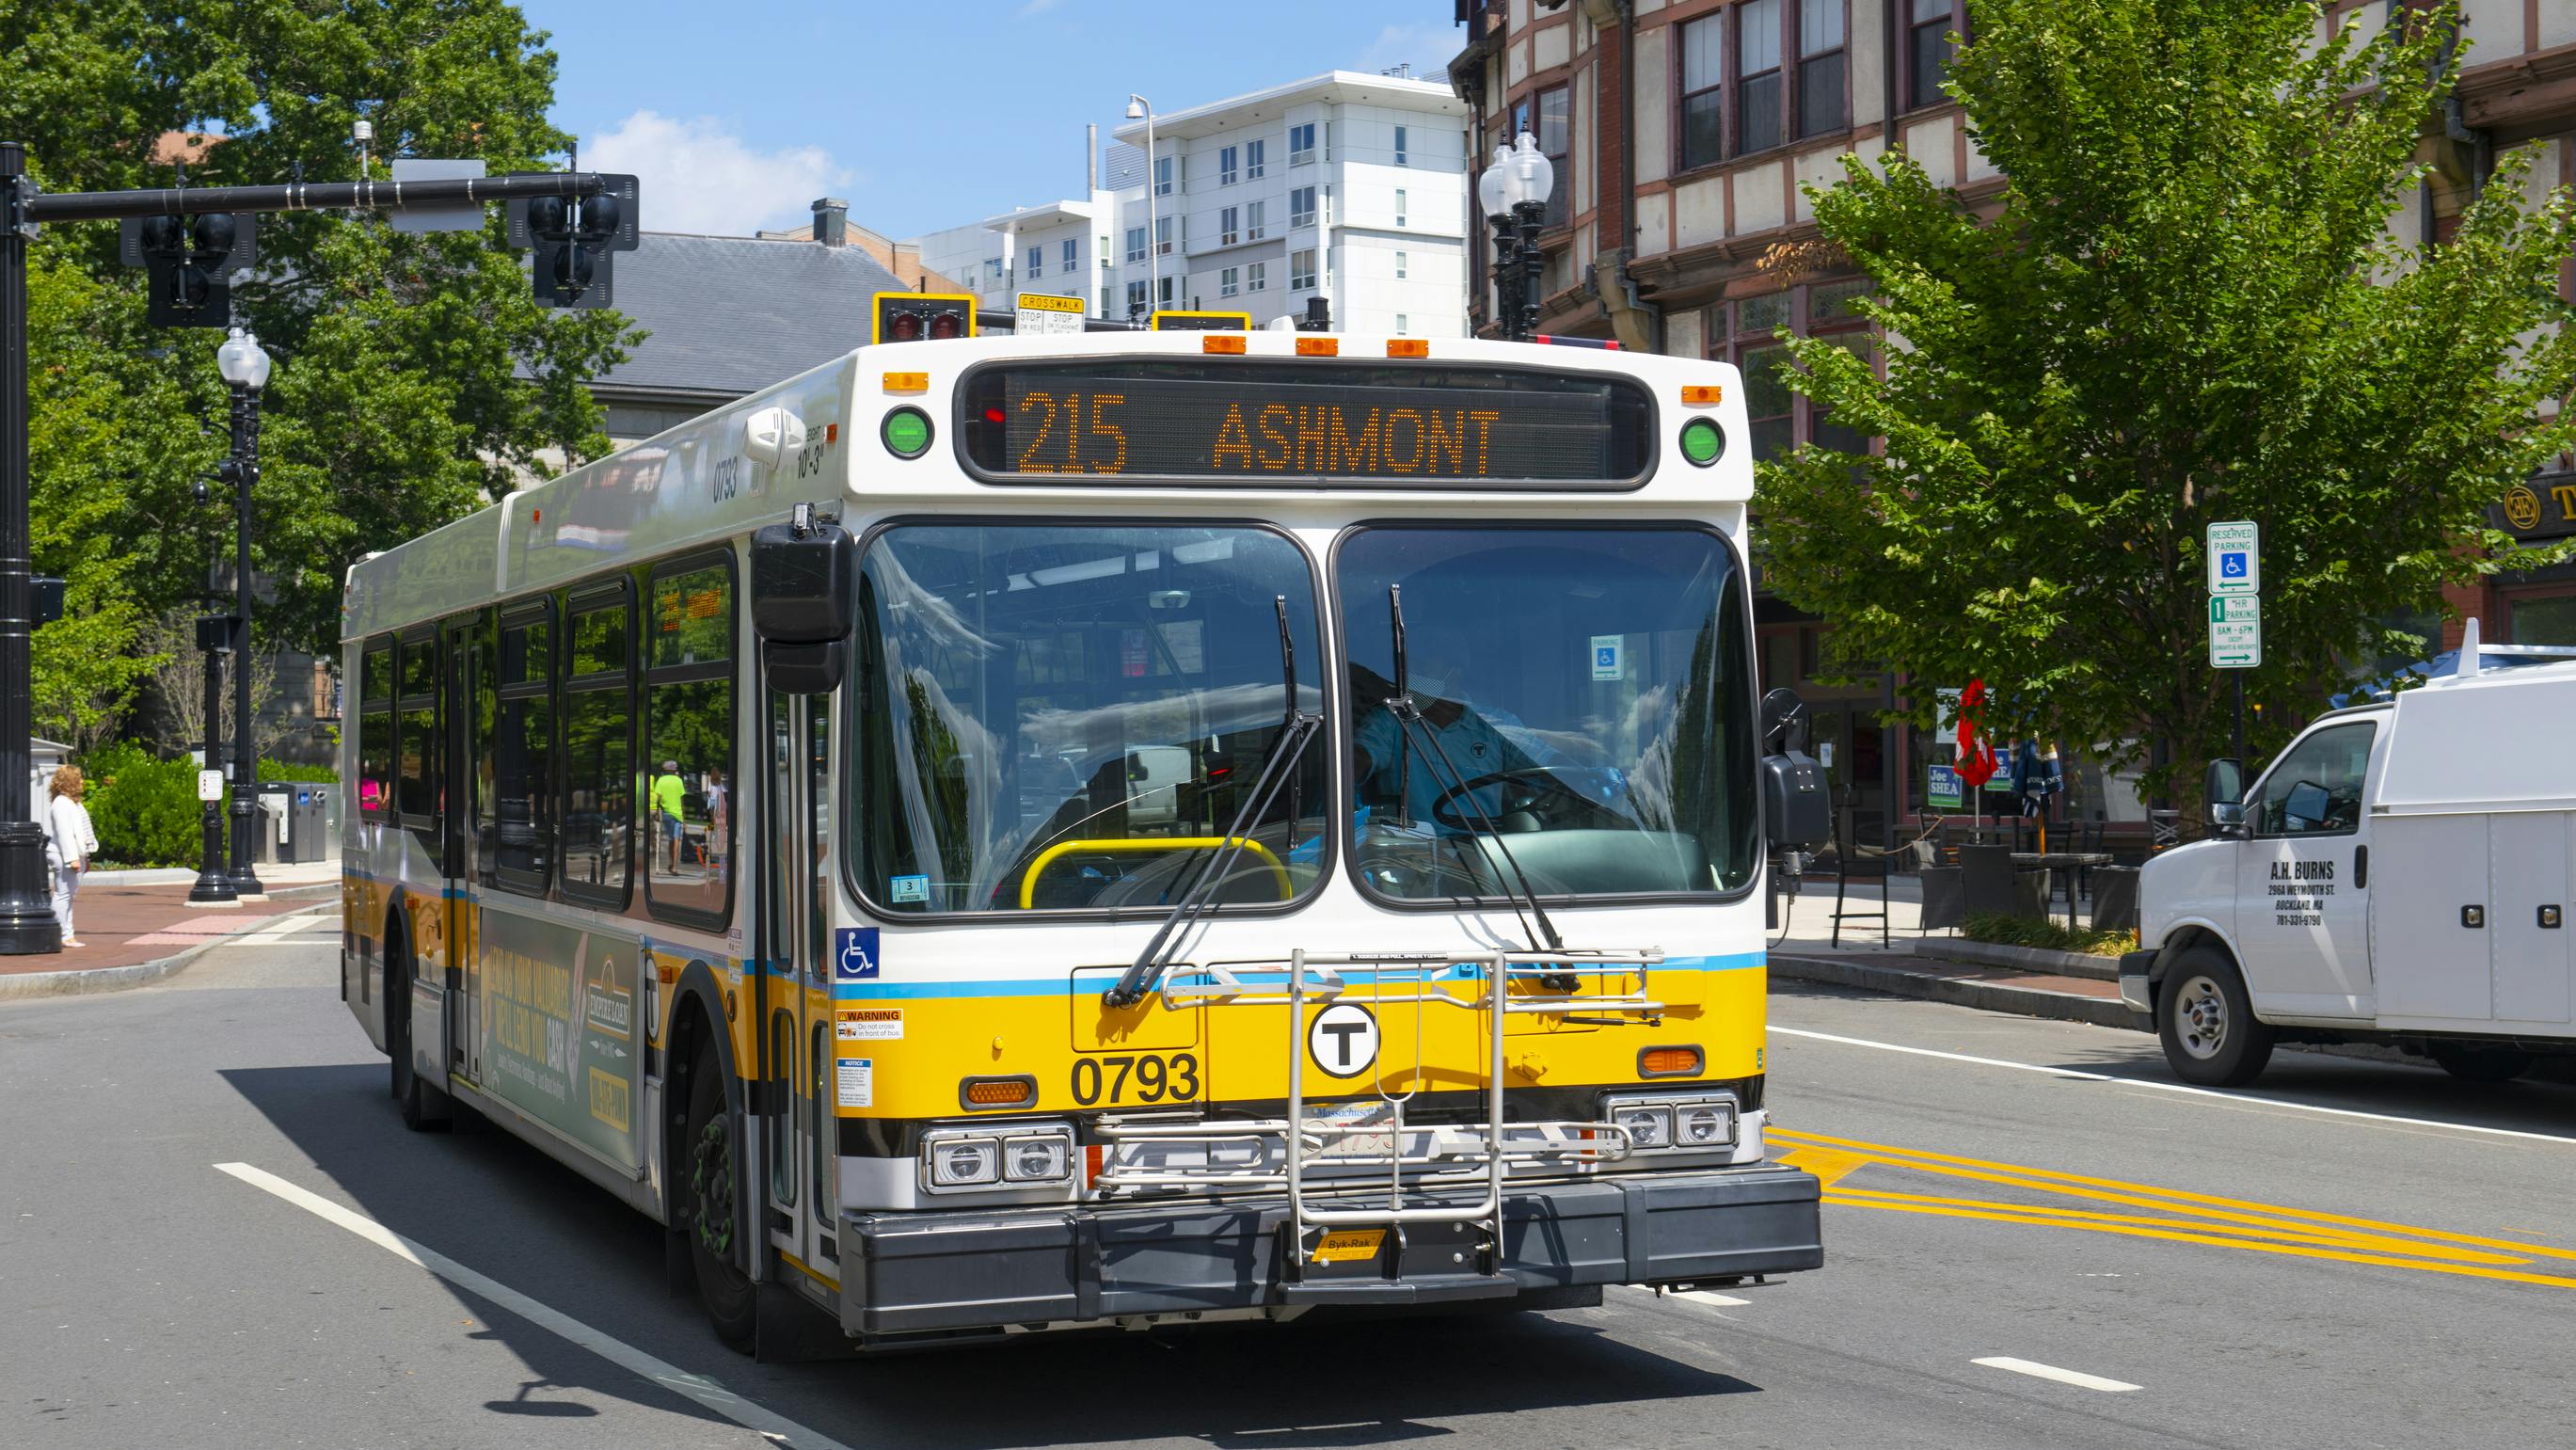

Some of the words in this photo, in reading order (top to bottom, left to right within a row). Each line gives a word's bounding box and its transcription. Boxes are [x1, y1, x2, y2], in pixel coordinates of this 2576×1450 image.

[1023, 296, 1080, 311] CROSSWALK
[1020, 311, 1042, 322] STOP
[1054, 313, 1073, 323] STOP
[1019, 391, 1127, 474] 215
[1213, 403, 1501, 475] ASHMONT
[713, 455, 739, 503] 0793
[2212, 530, 2252, 540] RESERVED
[2214, 542, 2250, 551] PARKING
[2215, 601, 2221, 619] 1
[2234, 599, 2248, 608] HR
[2226, 610, 2257, 619] PARKING
[2217, 626, 2232, 635] 8AM
[2238, 625, 2253, 635] 6PM
[1931, 770, 1948, 782] Joe
[1931, 782, 1959, 795] SHEA
[2270, 861, 2292, 880] A.H.
[2295, 860, 2334, 880] BURNS
[906, 882, 913, 891] 3
[2287, 884, 2325, 896] WEYMOUTH
[2313, 900, 2324, 911] MA
[590, 994, 612, 1026] EMPIRE
[612, 1000, 628, 1027] LOAN
[847, 1011, 899, 1021] WARNING
[547, 1017, 564, 1075] CASH
[1322, 1022, 1367, 1066] T
[1071, 1053, 1200, 1106] 0793
[1317, 1106, 1379, 1119] Massachusetts
[1328, 1238, 1371, 1251] Byk-Rak
